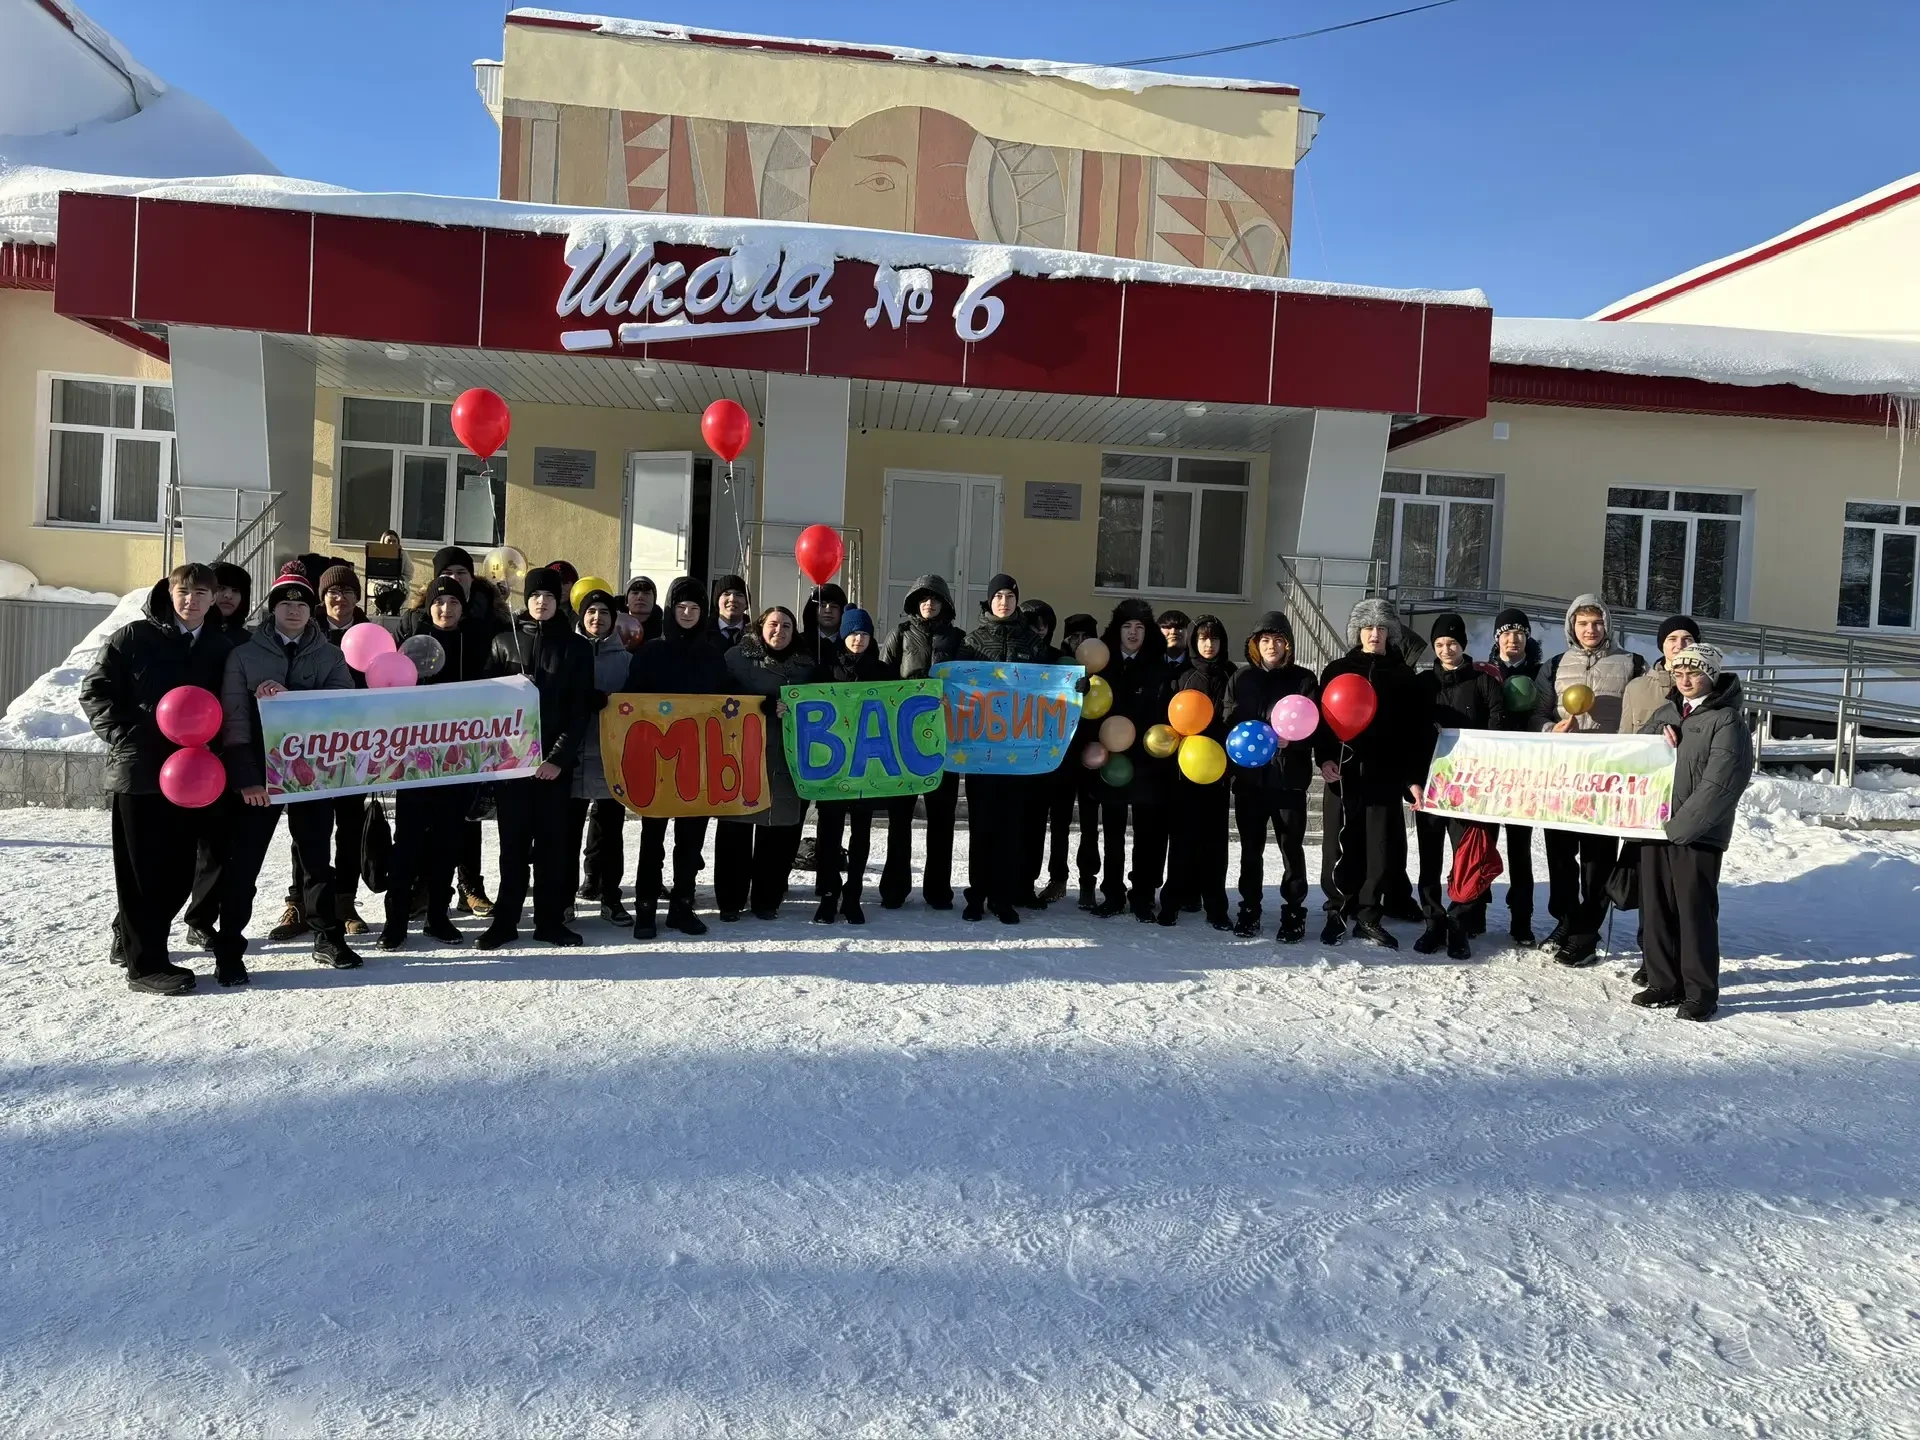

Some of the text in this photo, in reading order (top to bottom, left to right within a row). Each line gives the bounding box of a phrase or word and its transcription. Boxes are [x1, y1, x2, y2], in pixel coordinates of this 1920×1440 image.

[556, 240, 834, 318] Школа
[953, 268, 1013, 342] 6
[307, 709, 523, 762] праздником!
[621, 712, 762, 808] МЫ
[795, 695, 944, 782] ВАС
